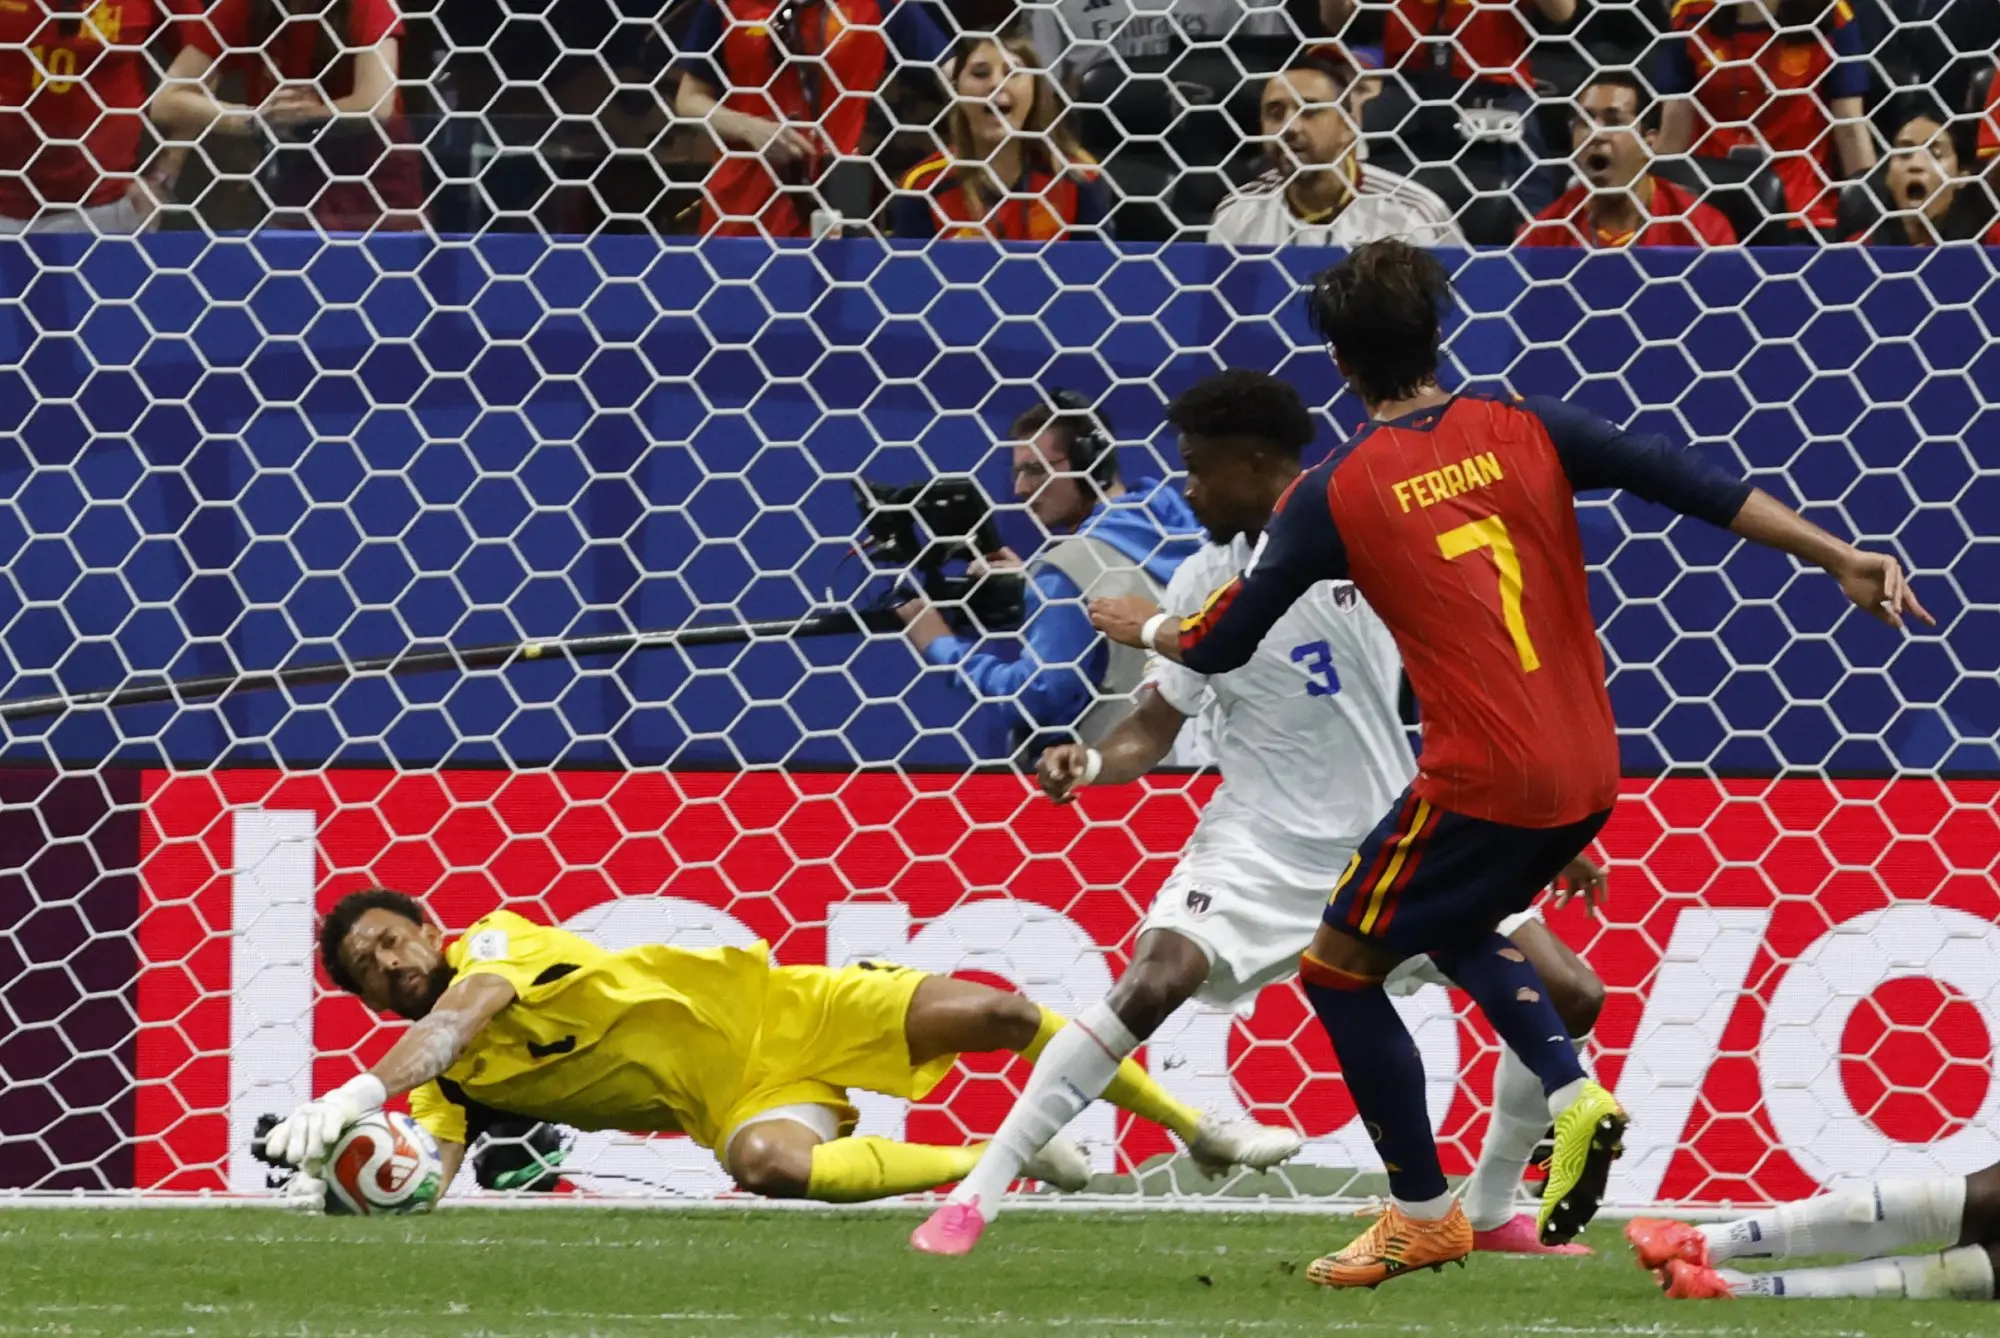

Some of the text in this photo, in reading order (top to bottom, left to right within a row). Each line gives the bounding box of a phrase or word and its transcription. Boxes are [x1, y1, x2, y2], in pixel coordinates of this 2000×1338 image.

[30, 45, 77, 95] 10
[1392, 452, 1504, 513] FERRAN
[1436, 515, 1542, 673] 7
[1289, 640, 1342, 697] 3
